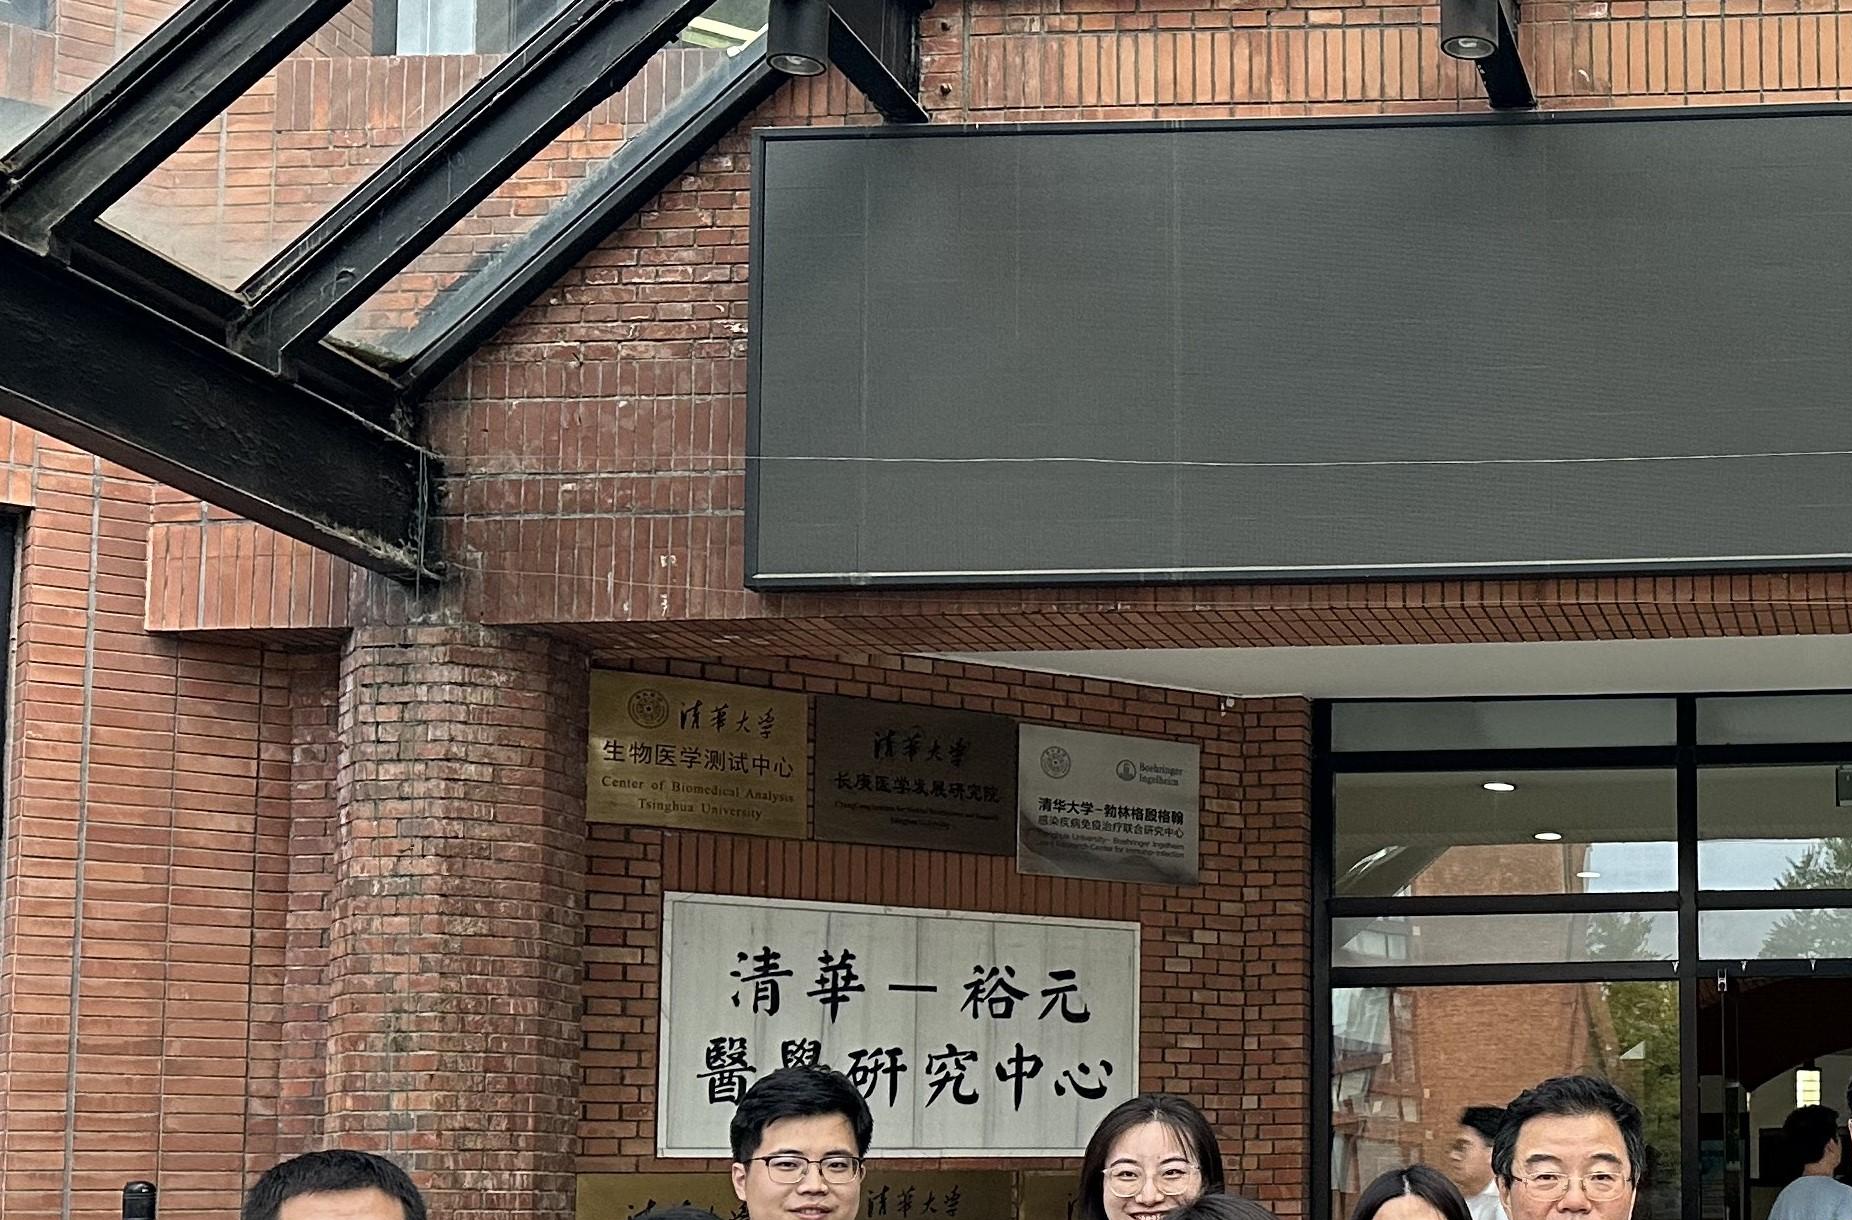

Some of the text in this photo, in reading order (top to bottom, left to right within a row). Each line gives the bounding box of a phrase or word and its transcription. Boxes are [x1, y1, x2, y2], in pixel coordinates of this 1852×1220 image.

[603, 740, 793, 778] 生物医学测试中心
[834, 772, 1000, 803] 长庚医学发展研究院
[1139, 762, 1183, 786] Boehringer Ingelheim
[601, 776, 794, 804] Center of Biomedical Analysis
[638, 799, 762, 820] Tsinghua University
